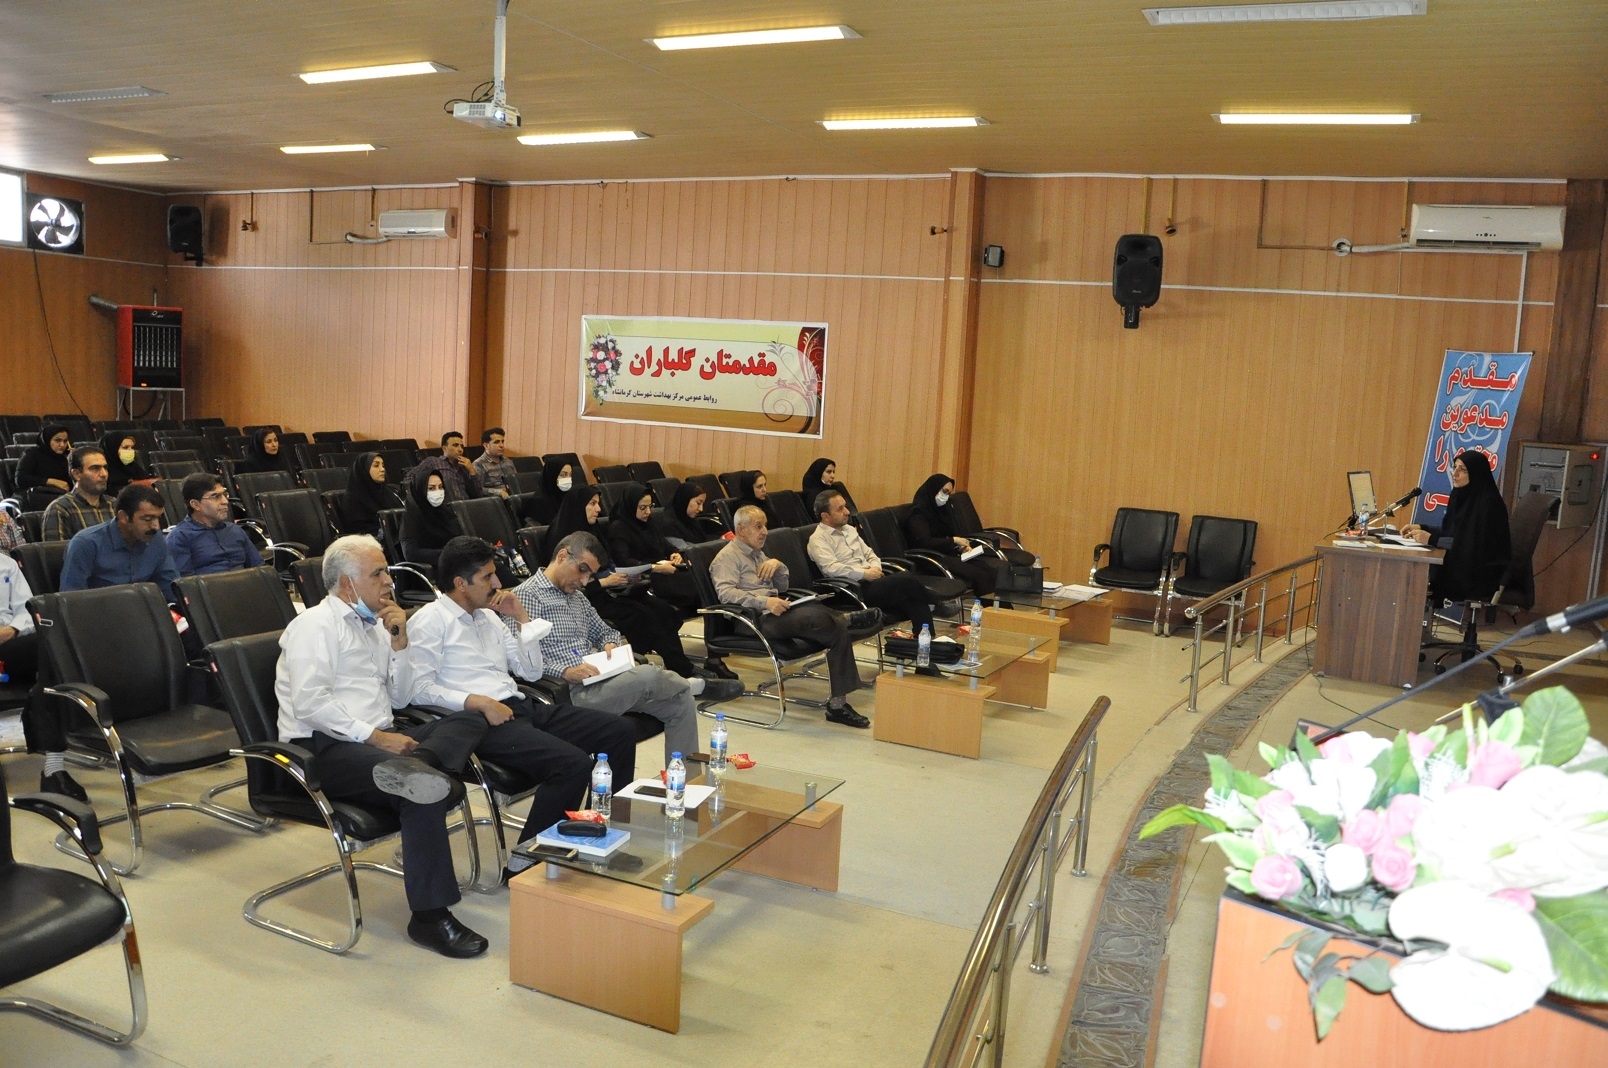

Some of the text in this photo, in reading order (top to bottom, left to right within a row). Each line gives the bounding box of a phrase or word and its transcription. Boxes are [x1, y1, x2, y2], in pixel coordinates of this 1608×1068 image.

[628, 345, 778, 380] مقدمتان گلباران
[1447, 361, 1519, 394] مقدم
[612, 388, 718, 404] روابط عمومی مرکز بهداشت شهرستان کرمانشاه
[1440, 403, 1509, 434] مدعوین
[1434, 434, 1450, 472] را
